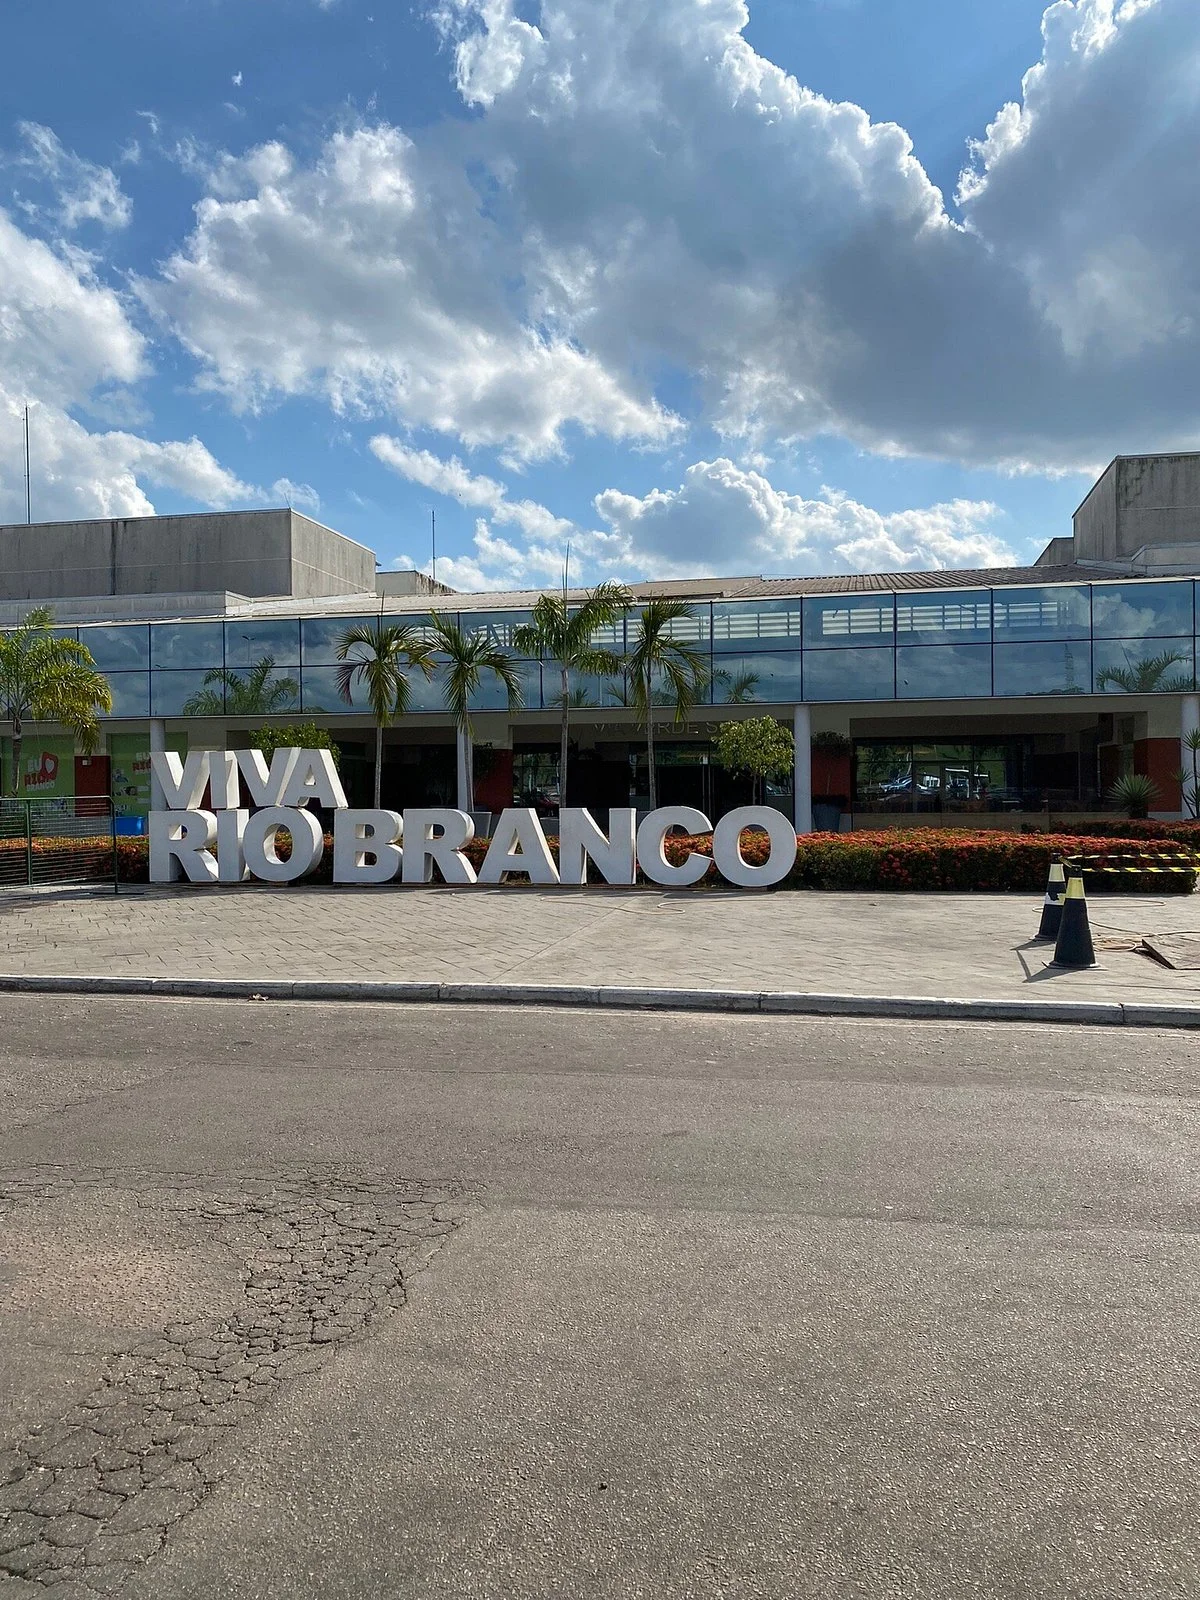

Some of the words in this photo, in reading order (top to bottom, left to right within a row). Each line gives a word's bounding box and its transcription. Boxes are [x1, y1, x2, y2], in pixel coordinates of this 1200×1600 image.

[150, 747, 348, 809] VIVA
[149, 807, 323, 882] RIO
[333, 806, 797, 886] BRANCO
